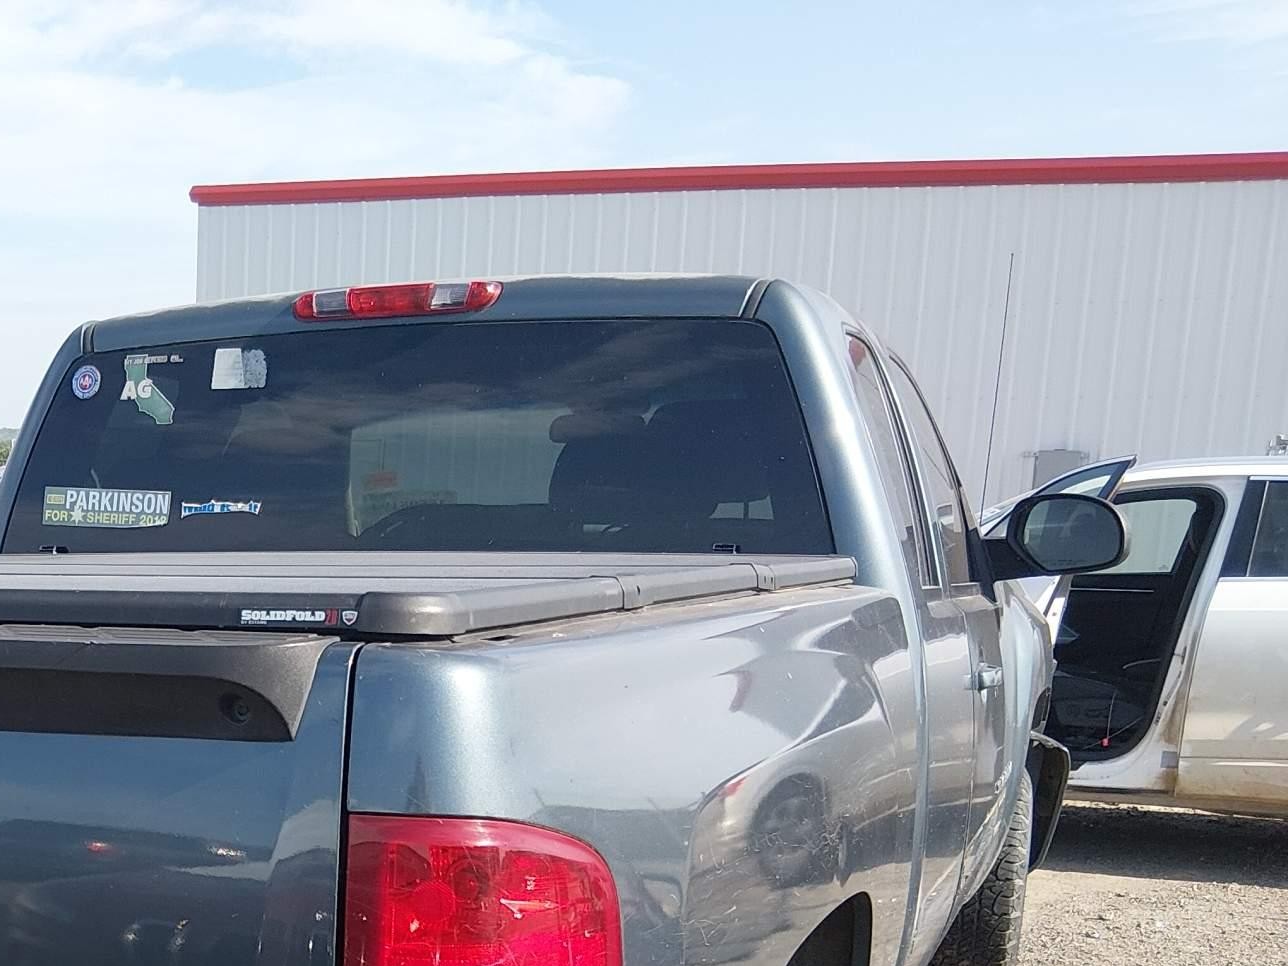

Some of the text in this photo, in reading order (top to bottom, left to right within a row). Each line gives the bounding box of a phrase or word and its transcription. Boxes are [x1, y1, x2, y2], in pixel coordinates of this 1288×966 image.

[120, 378, 153, 401] AG
[65, 490, 170, 515] PARKINSON
[45, 509, 68, 522] FOR
[86, 513, 136, 525] SHERIFF
